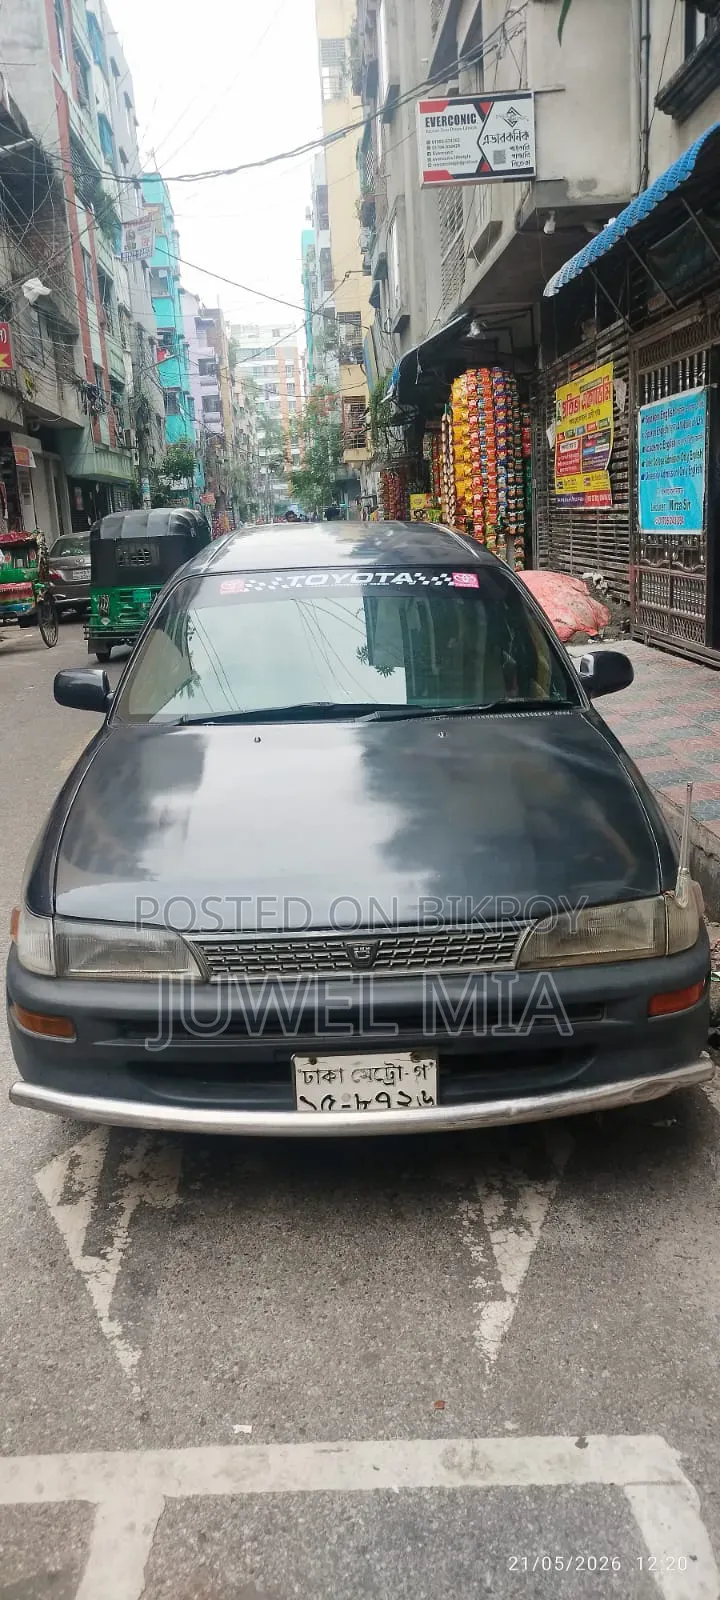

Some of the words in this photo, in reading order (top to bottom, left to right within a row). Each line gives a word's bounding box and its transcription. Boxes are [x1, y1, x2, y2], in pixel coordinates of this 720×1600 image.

[425, 113, 477, 128] EVERCONIC
[288, 572, 415, 586] TOYOTA
[299, 1067, 344, 1084] ঢাকা
